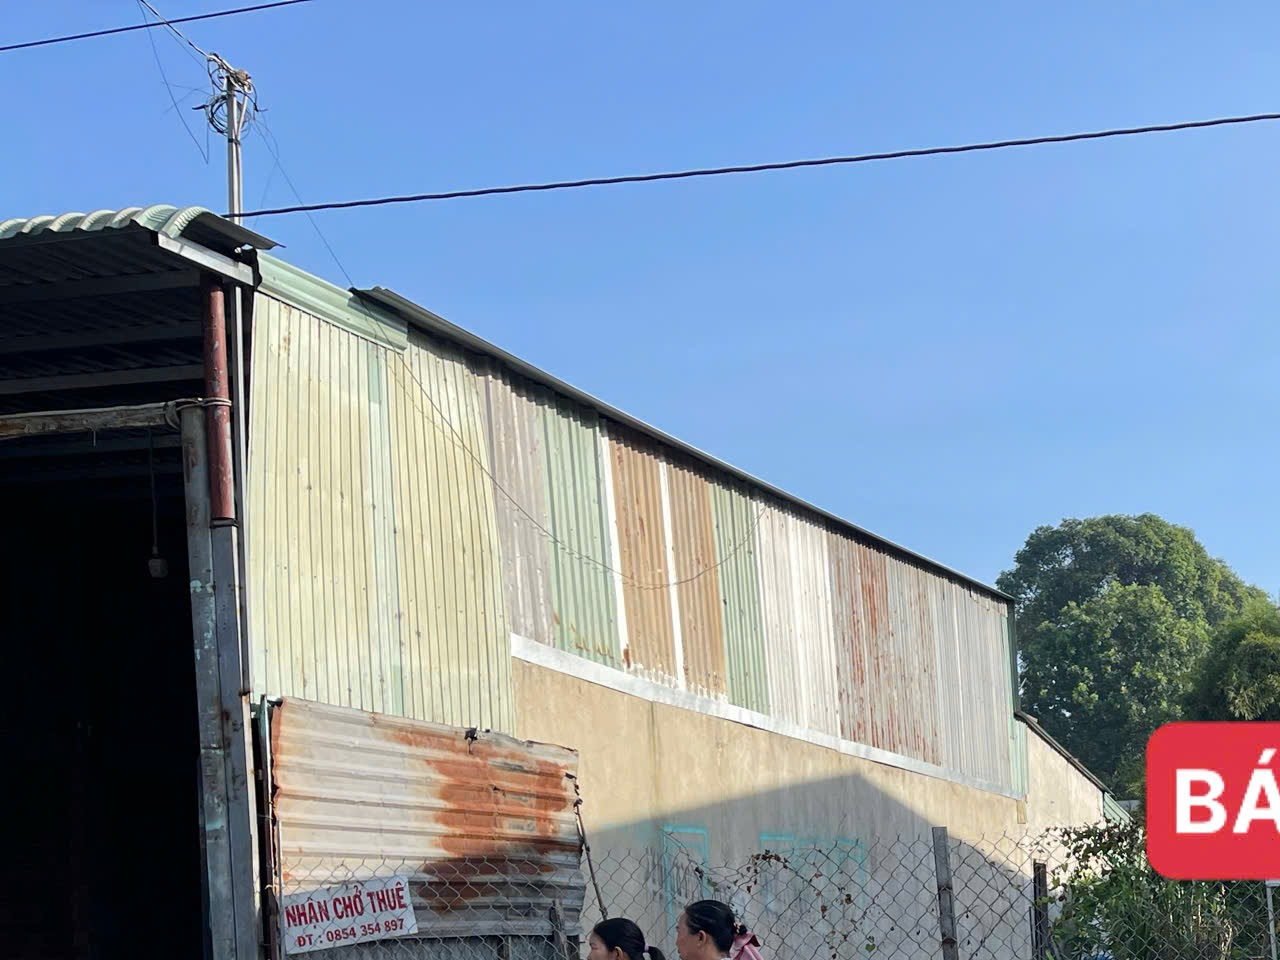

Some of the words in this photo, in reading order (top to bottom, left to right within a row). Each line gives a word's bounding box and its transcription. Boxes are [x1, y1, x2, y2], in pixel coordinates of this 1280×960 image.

[285, 898, 329, 930] NHẬN
[332, 885, 364, 919] CHỞ
[367, 881, 407, 914] THUÊ
[326, 927, 356, 943] 0854
[360, 922, 381, 937] 354
[384, 918, 405, 932] 897
